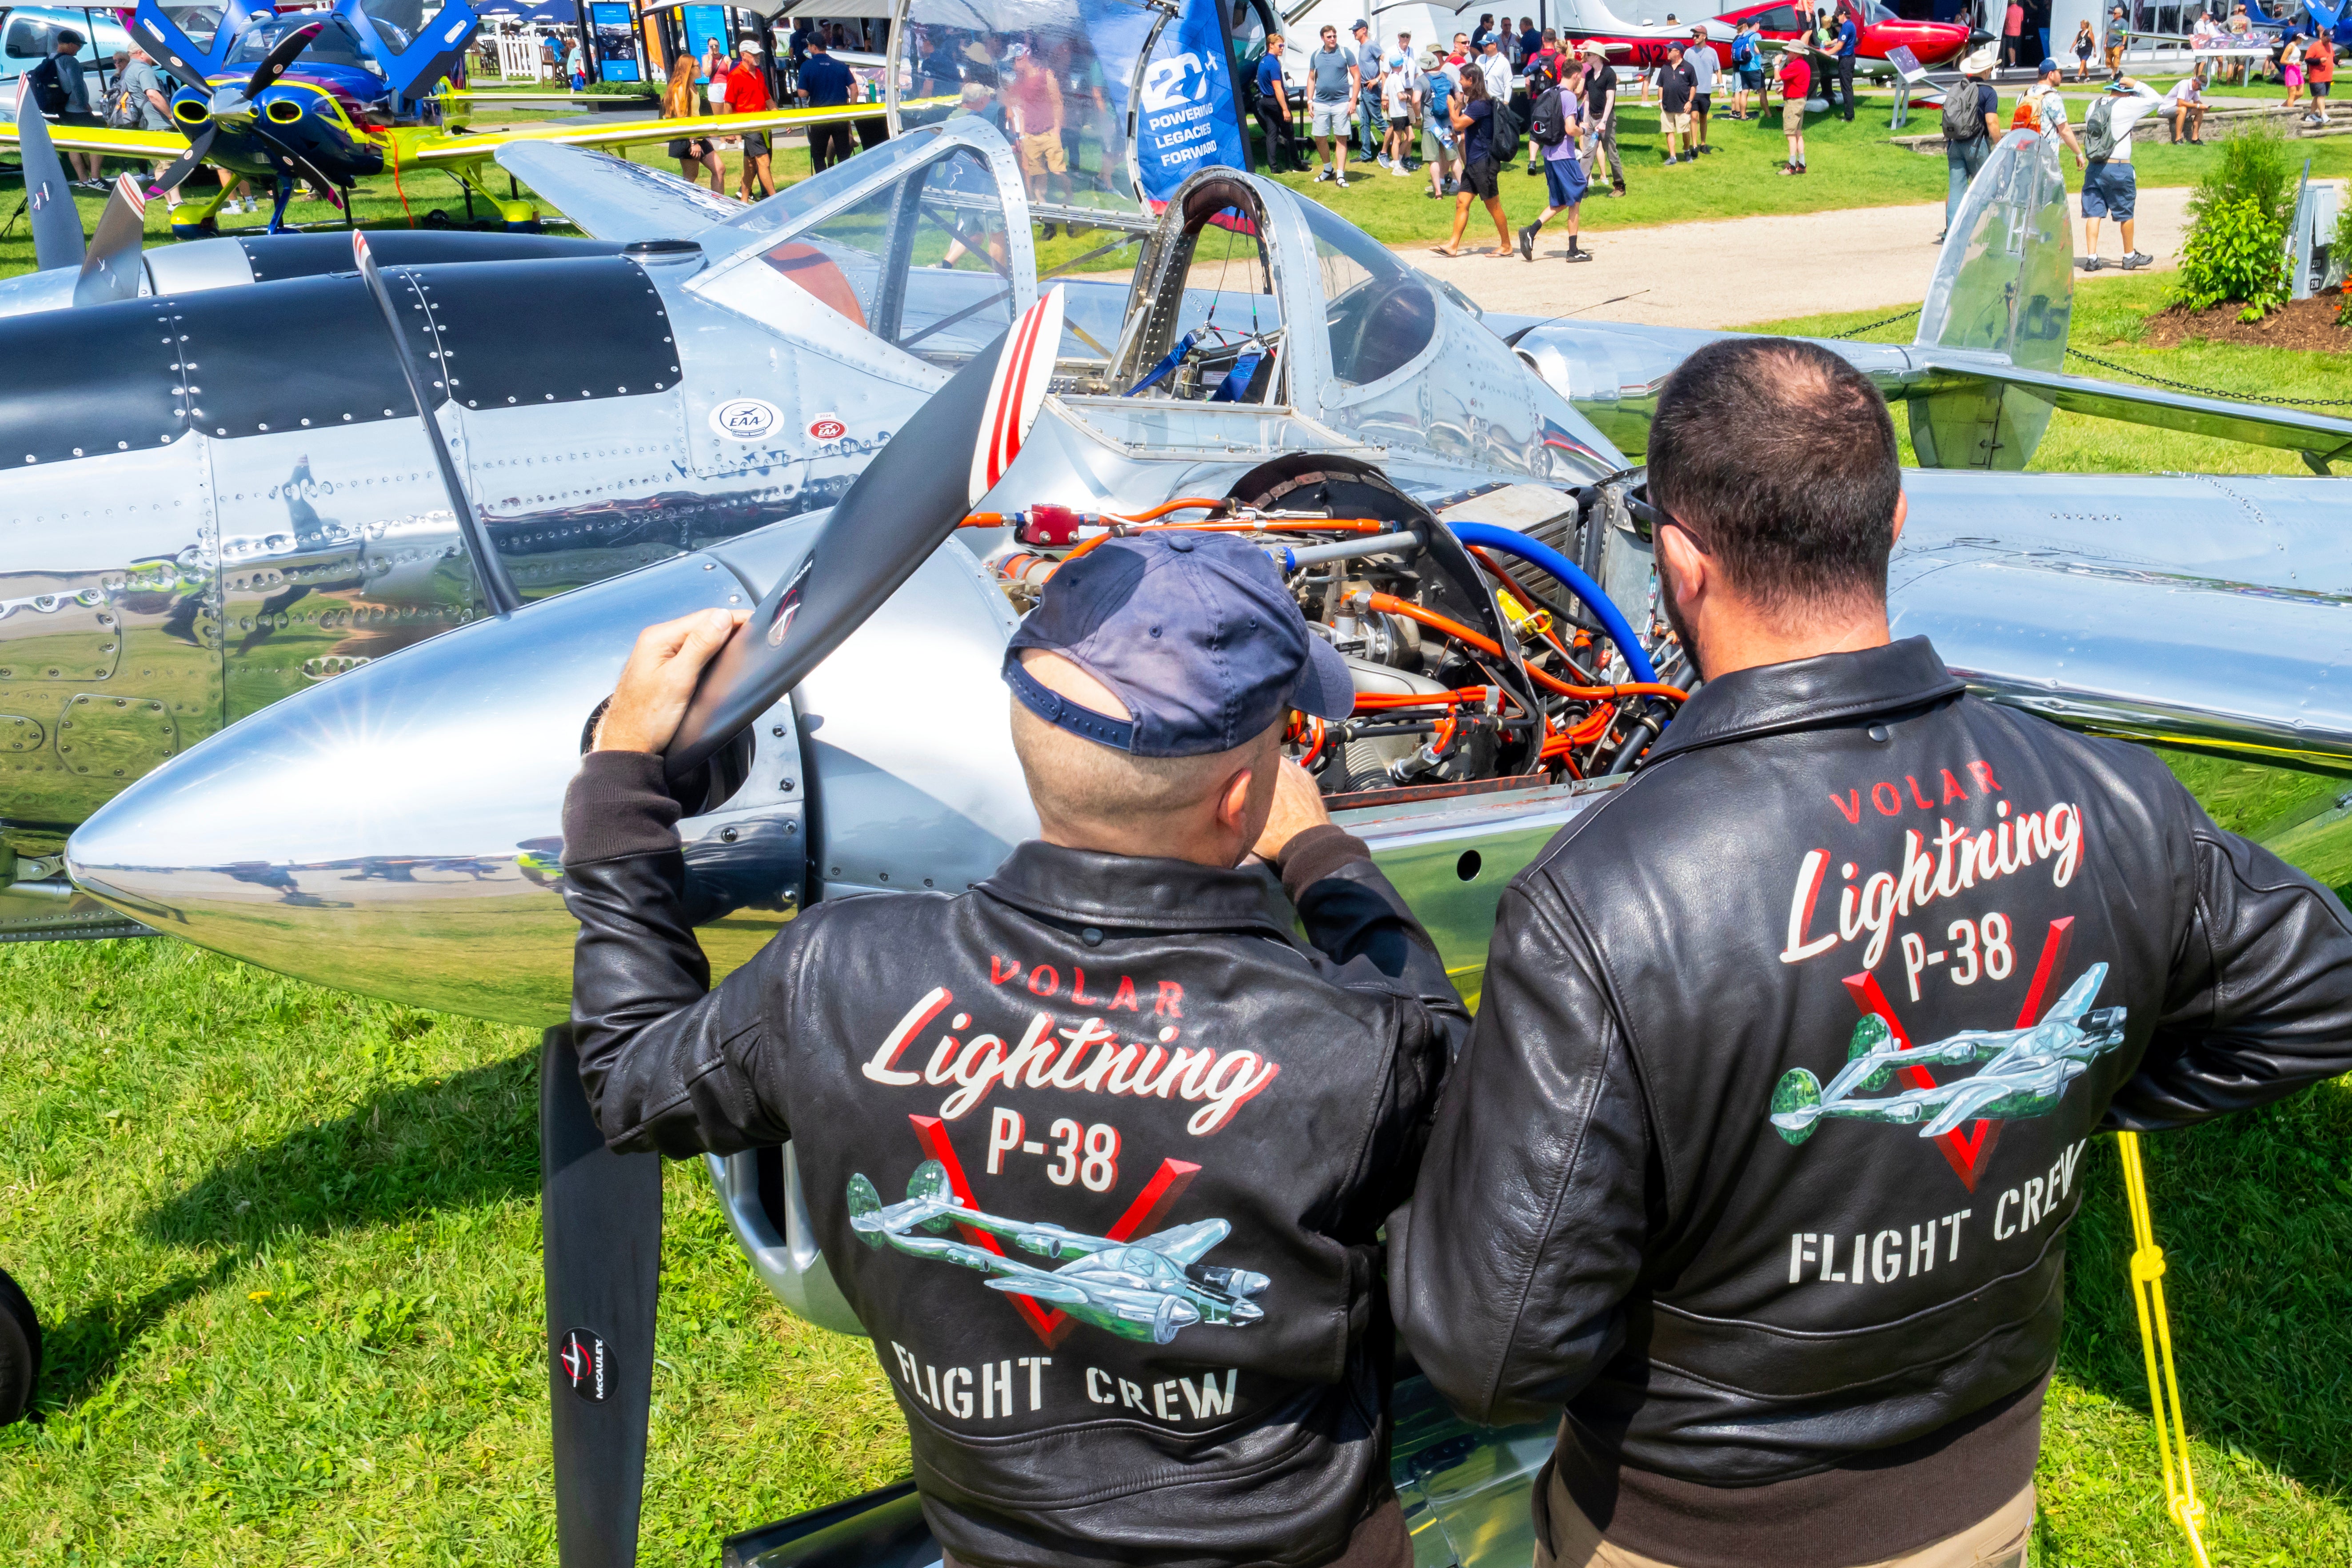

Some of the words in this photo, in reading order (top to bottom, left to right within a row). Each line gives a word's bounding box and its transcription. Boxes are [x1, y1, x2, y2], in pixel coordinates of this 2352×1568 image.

[1149, 102, 1214, 131] POWERING
[1154, 122, 1212, 149] LEGACIES
[1160, 140, 1217, 167] FORWARD
[729, 416, 758, 427] EAA
[1829, 760, 2002, 824] VOLAR
[1780, 800, 2084, 970] Lightning
[990, 955, 1184, 1018] VOLAR
[1901, 911, 2017, 1002] P-38
[862, 986, 1280, 1136] Lightning
[986, 1106, 1121, 1193] P-38
[1789, 1208, 1973, 1284] FLIGHT
[1993, 1137, 2087, 1241] CREW
[891, 1341, 1052, 1419] FLIGHT
[1086, 1366, 1237, 1421] CREW
